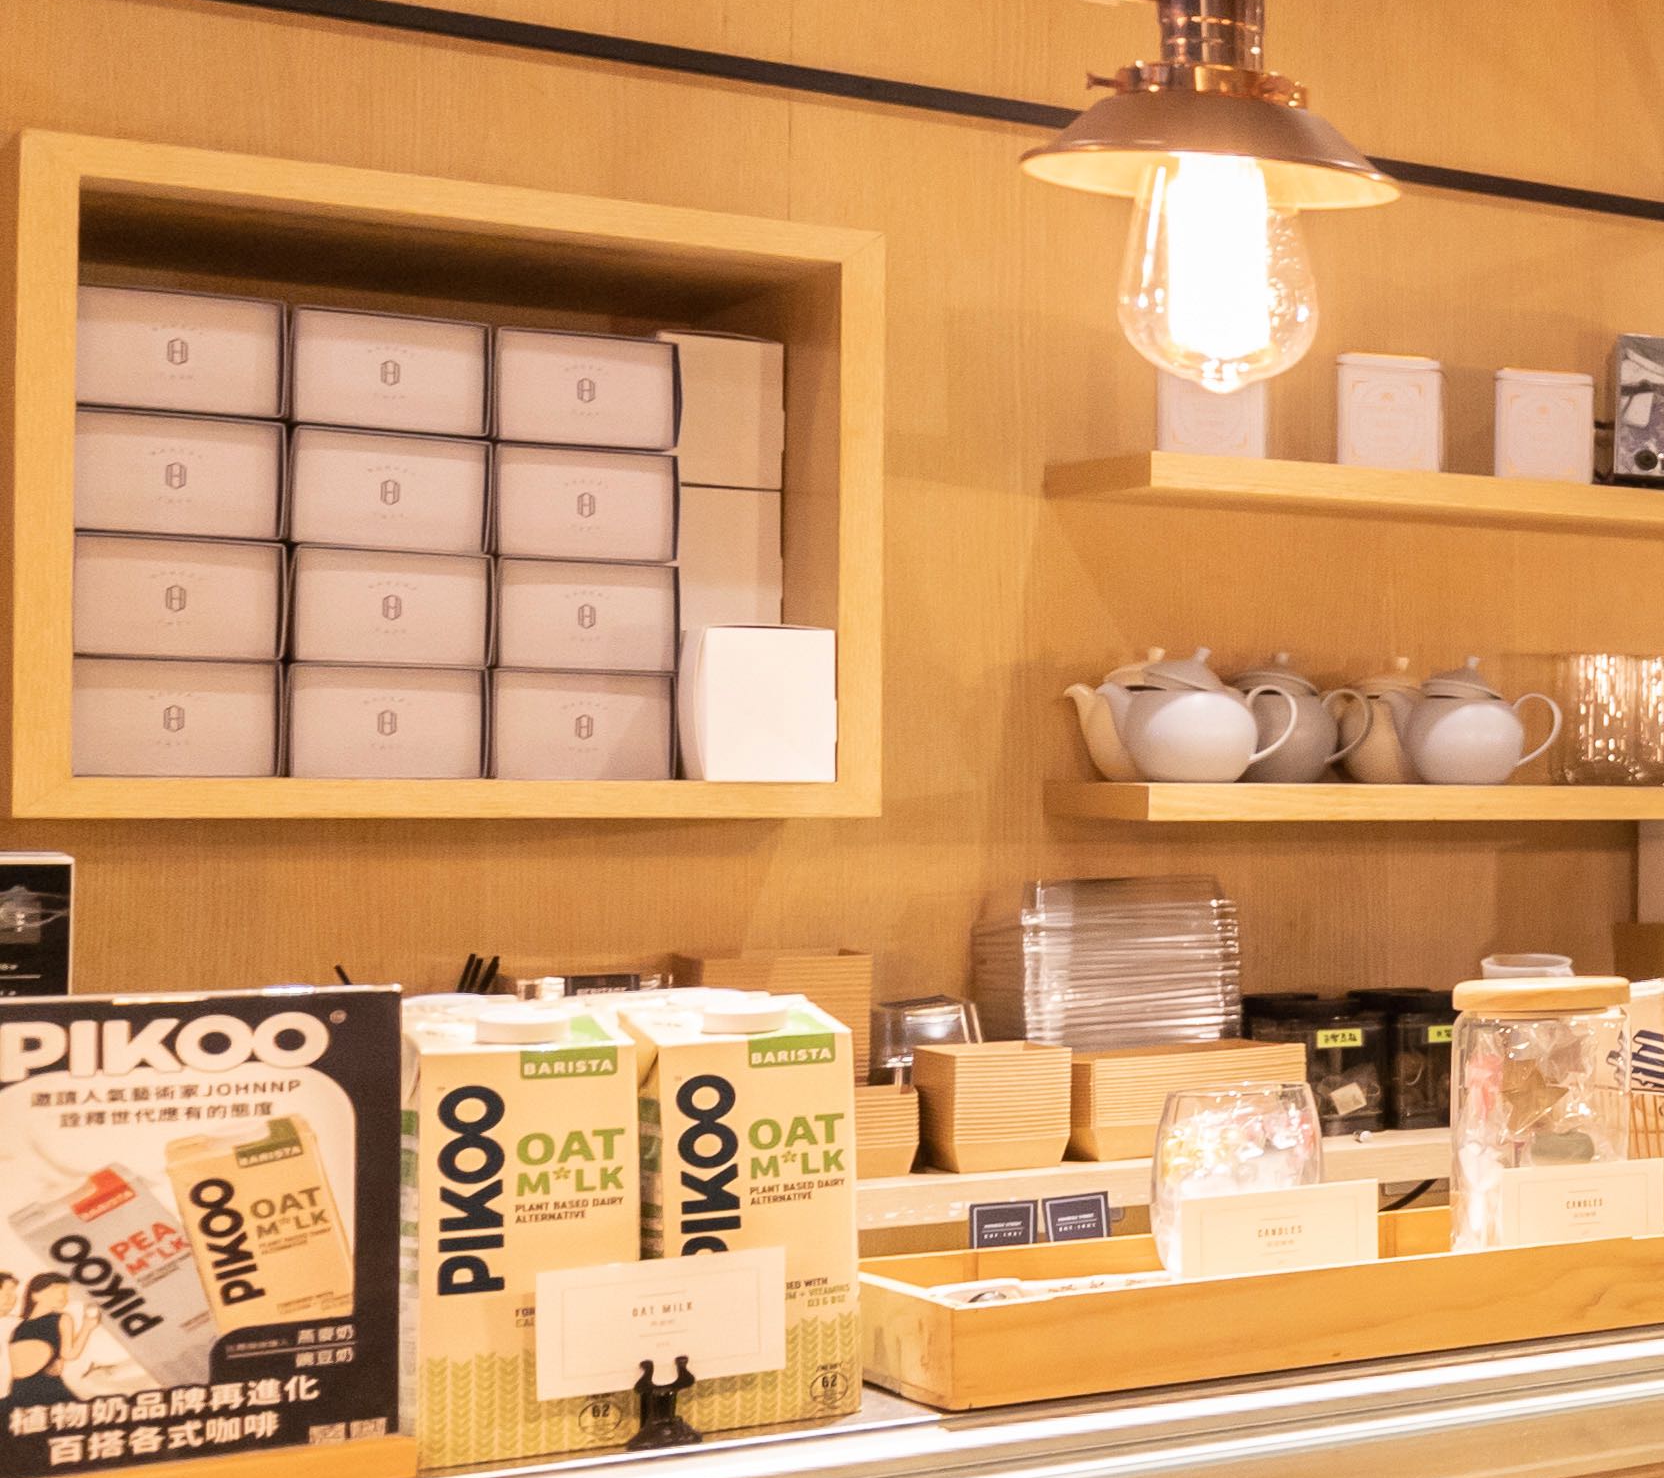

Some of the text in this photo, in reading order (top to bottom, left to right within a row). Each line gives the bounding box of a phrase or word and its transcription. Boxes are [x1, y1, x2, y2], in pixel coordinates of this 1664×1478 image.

[0, 1011, 330, 1082] PIKOO
[751, 1047, 831, 1065] BARISTA
[523, 1058, 614, 1077] BARISTA
[748, 1113, 845, 1150] OAT
[515, 1128, 625, 1166] OAT
[437, 1085, 506, 1296] PIKOO
[749, 1177, 845, 1196] PLANT BASED DAIRY
[750, 1191, 812, 1207] ALTERNATIVE
[250, 1187, 321, 1219] OAT
[515, 1196, 623, 1214] PLANT BASED DAIRY
[1566, 1198, 1603, 1209] CANDLES
[515, 1209, 586, 1224] ALTERNATIVE
[109, 1222, 177, 1262] PEA
[189, 1178, 267, 1306] PIKOO
[1258, 1225, 1302, 1237] CANDLES
[50, 1234, 164, 1338] PIKOO
[632, 1301, 694, 1317] OAT MILK
[822, 1375, 838, 1387] 62
[8, 1374, 320, 1437] 植物奶品牌再進化
[48, 1411, 280, 1466] 百搭各式咖啡
